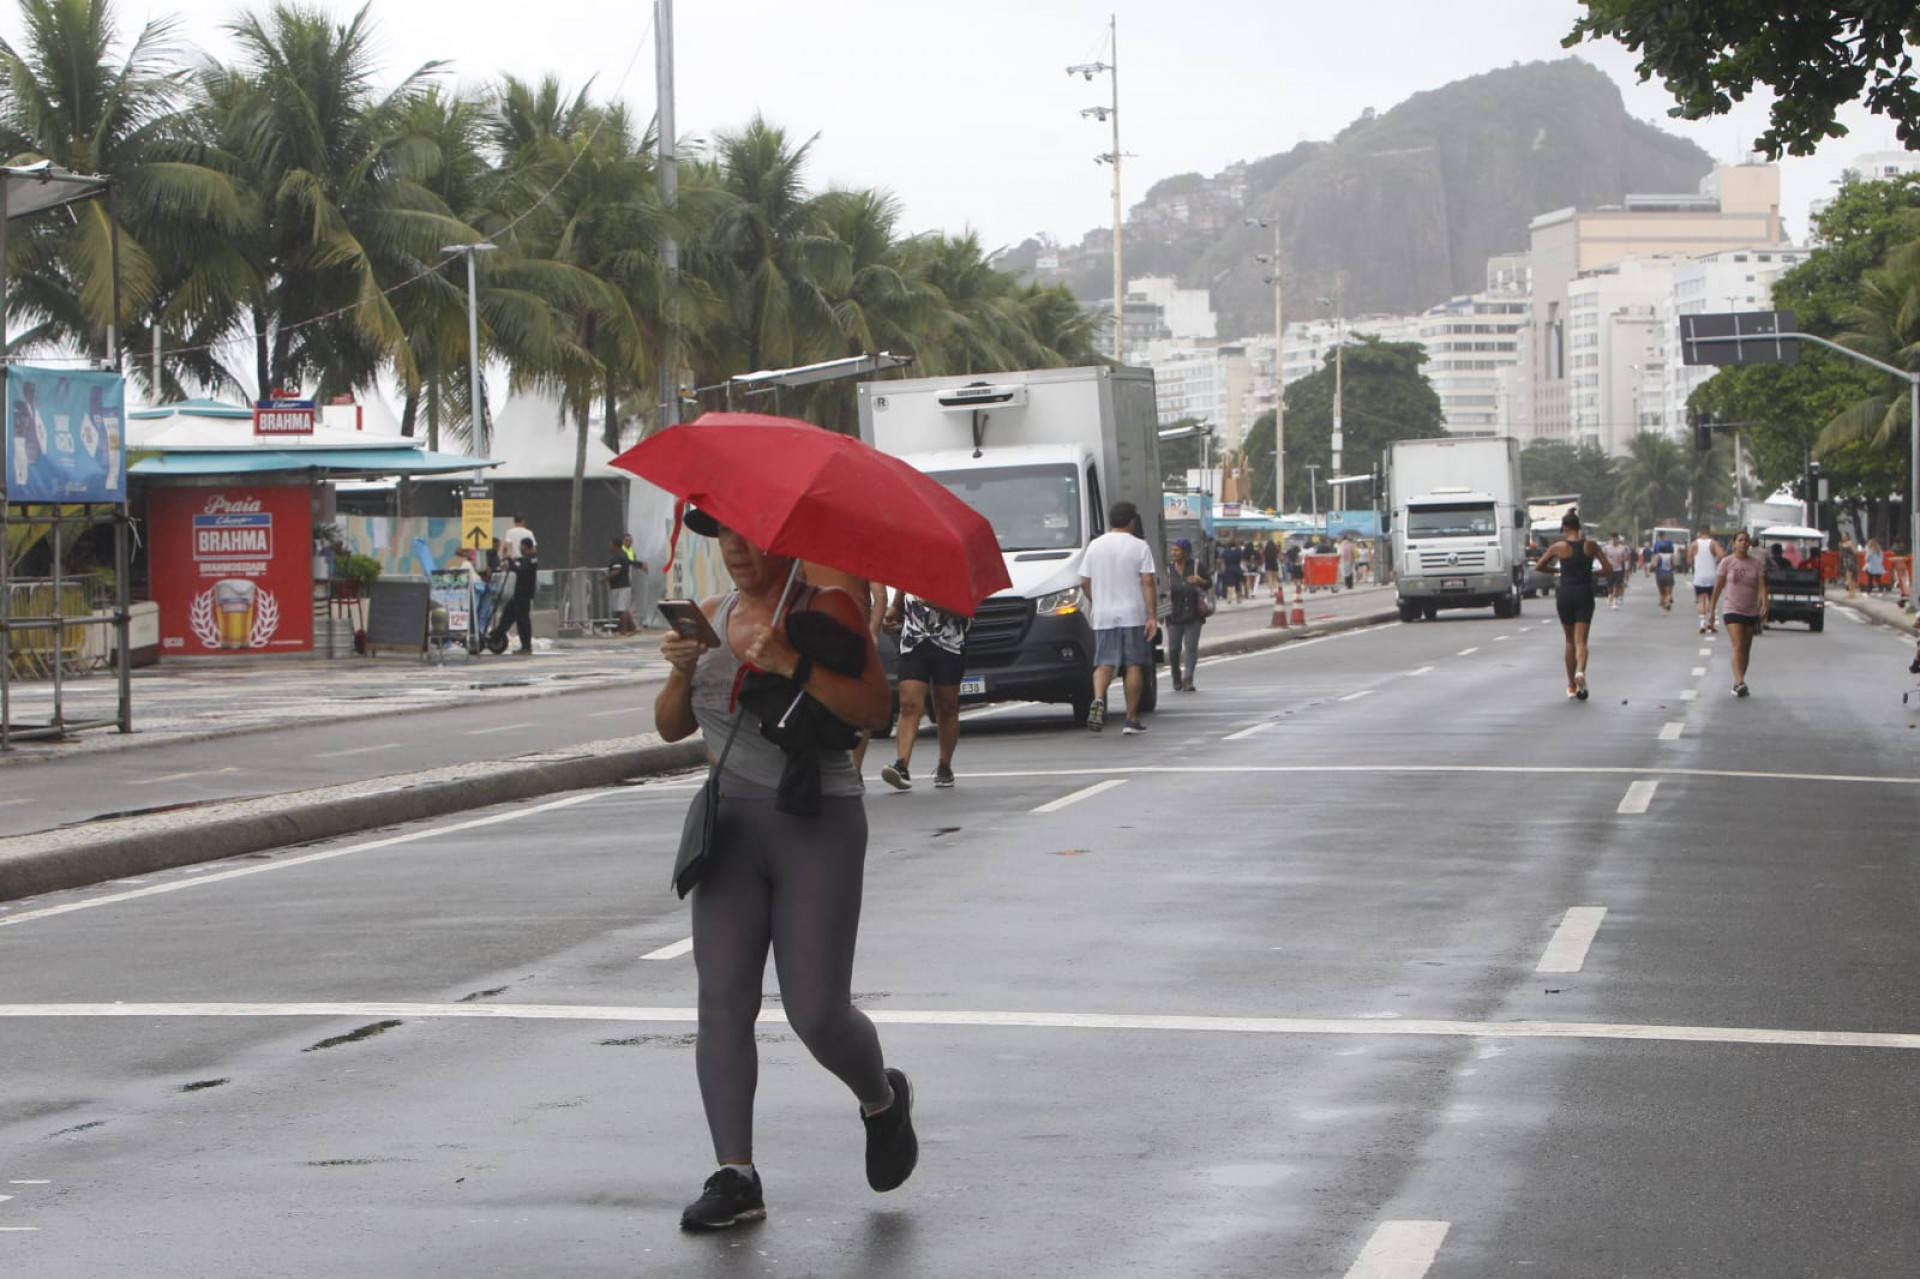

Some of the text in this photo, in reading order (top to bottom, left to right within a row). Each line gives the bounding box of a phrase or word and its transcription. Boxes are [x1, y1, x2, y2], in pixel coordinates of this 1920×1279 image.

[259, 413, 312, 431] BRAHMA
[204, 494, 263, 514] Praia
[199, 529, 267, 552] BRAHMA
